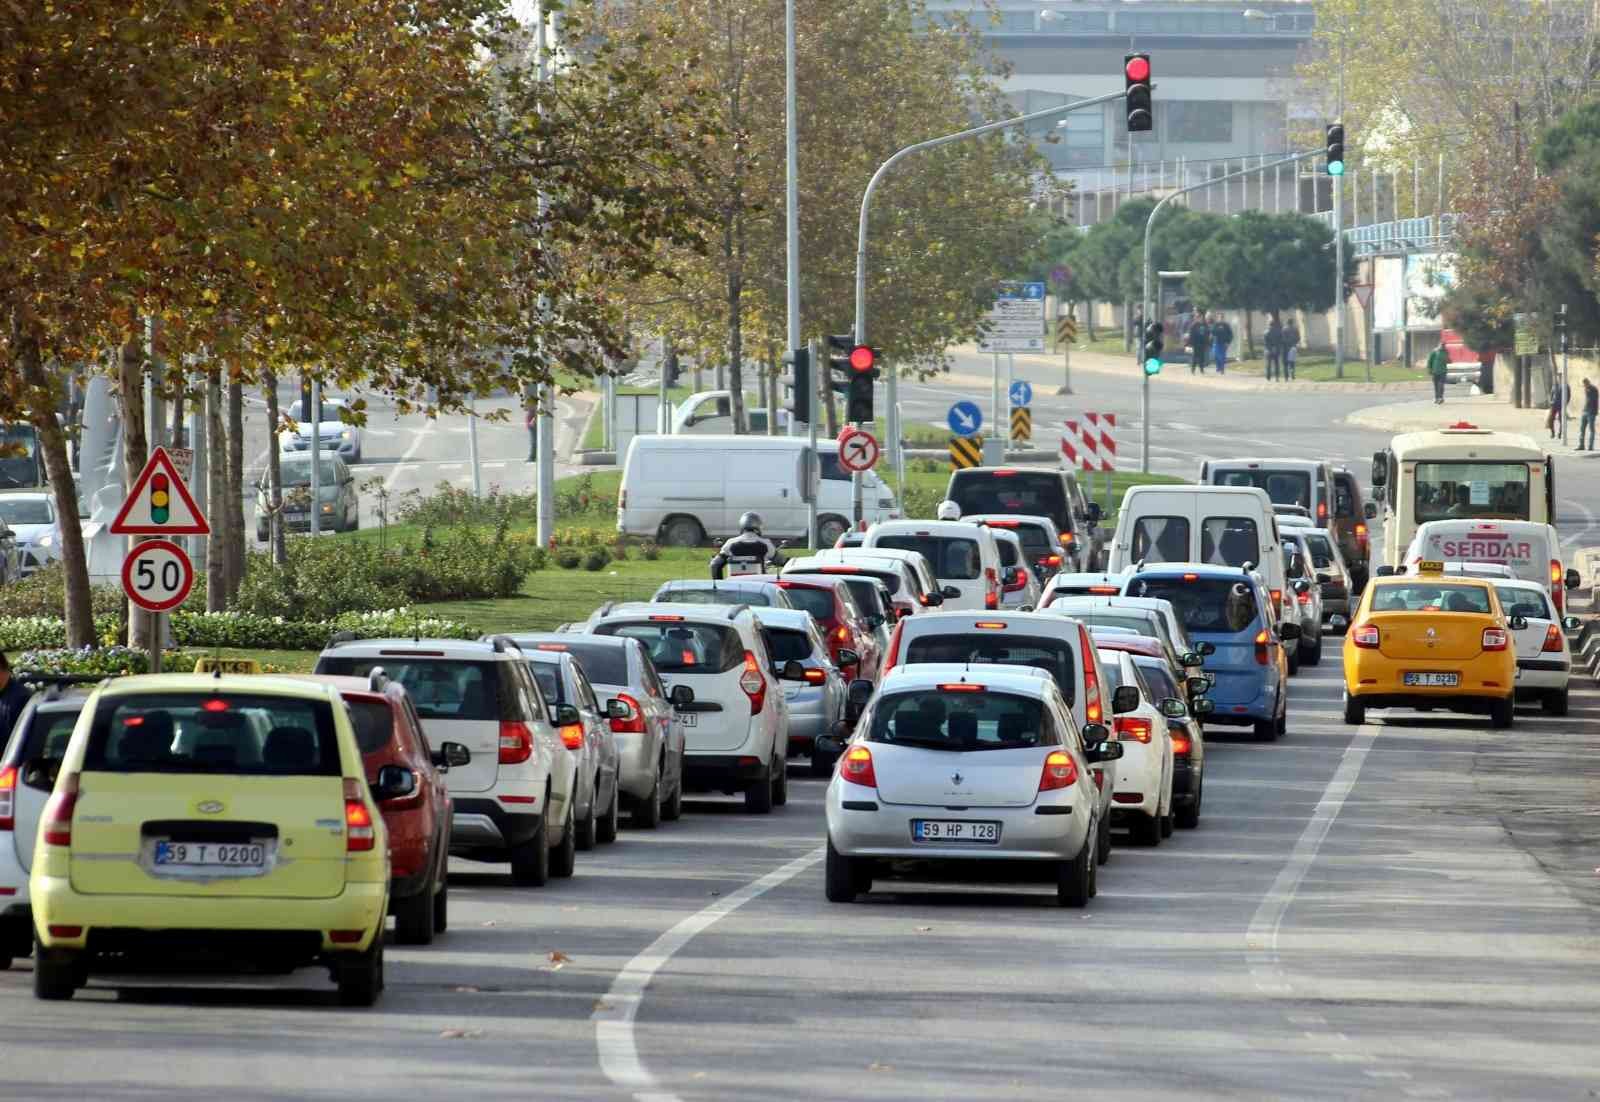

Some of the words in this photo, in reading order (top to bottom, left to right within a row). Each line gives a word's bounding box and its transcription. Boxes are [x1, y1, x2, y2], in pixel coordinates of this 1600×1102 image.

[1443, 541, 1531, 558] SERDAR
[137, 559, 180, 592] 50
[924, 823, 940, 836] 59
[946, 823, 962, 836] HP
[972, 825, 995, 838] 128
[166, 844, 187, 861] 59
[197, 846, 207, 861] T
[218, 846, 260, 862] 0200
